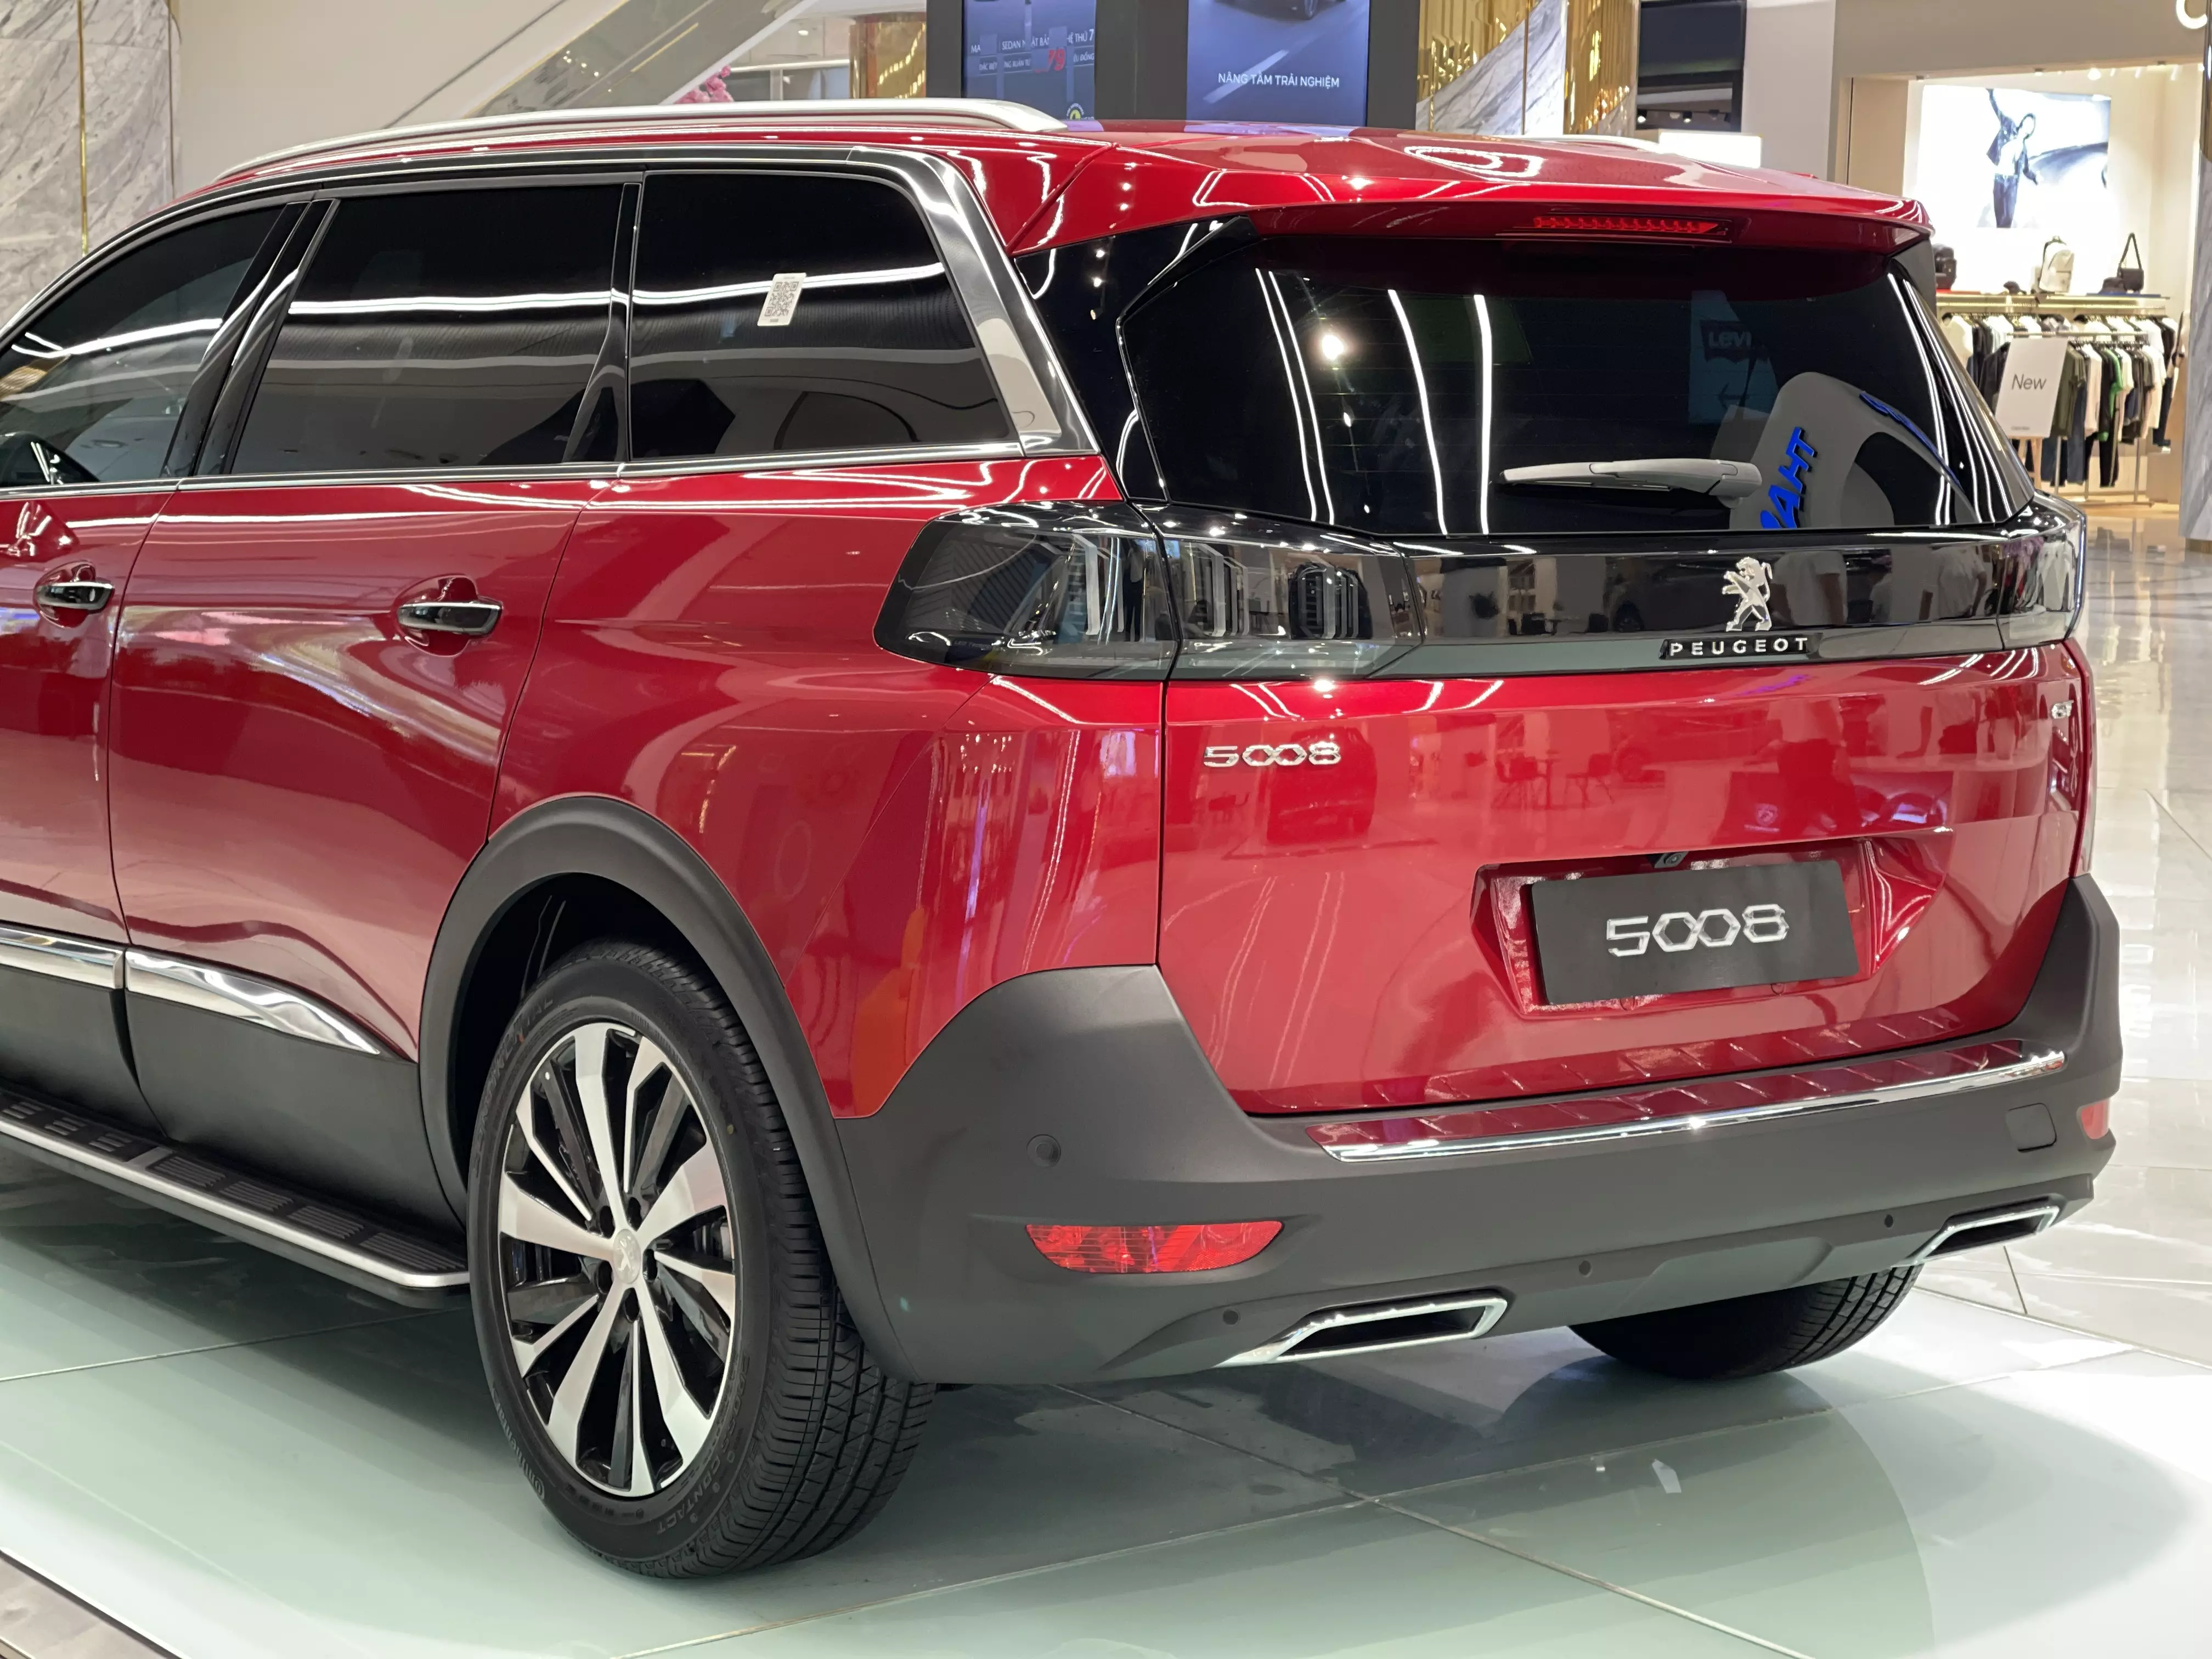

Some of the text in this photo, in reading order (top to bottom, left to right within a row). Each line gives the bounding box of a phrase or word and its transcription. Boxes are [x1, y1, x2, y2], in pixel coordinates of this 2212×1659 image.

[1002, 40, 1021, 50] SEDAN
[1089, 29, 1094, 41] 7
[1218, 71, 1248, 84] NÂNG
[1274, 72, 1298, 86] TRẢI
[1300, 75, 1340, 90] NGHIỆM
[2012, 373, 2047, 390] New
[1669, 637, 1808, 657] PEUGEOT
[1203, 741, 1341, 768] 5008
[1606, 903, 1789, 957] 5008
